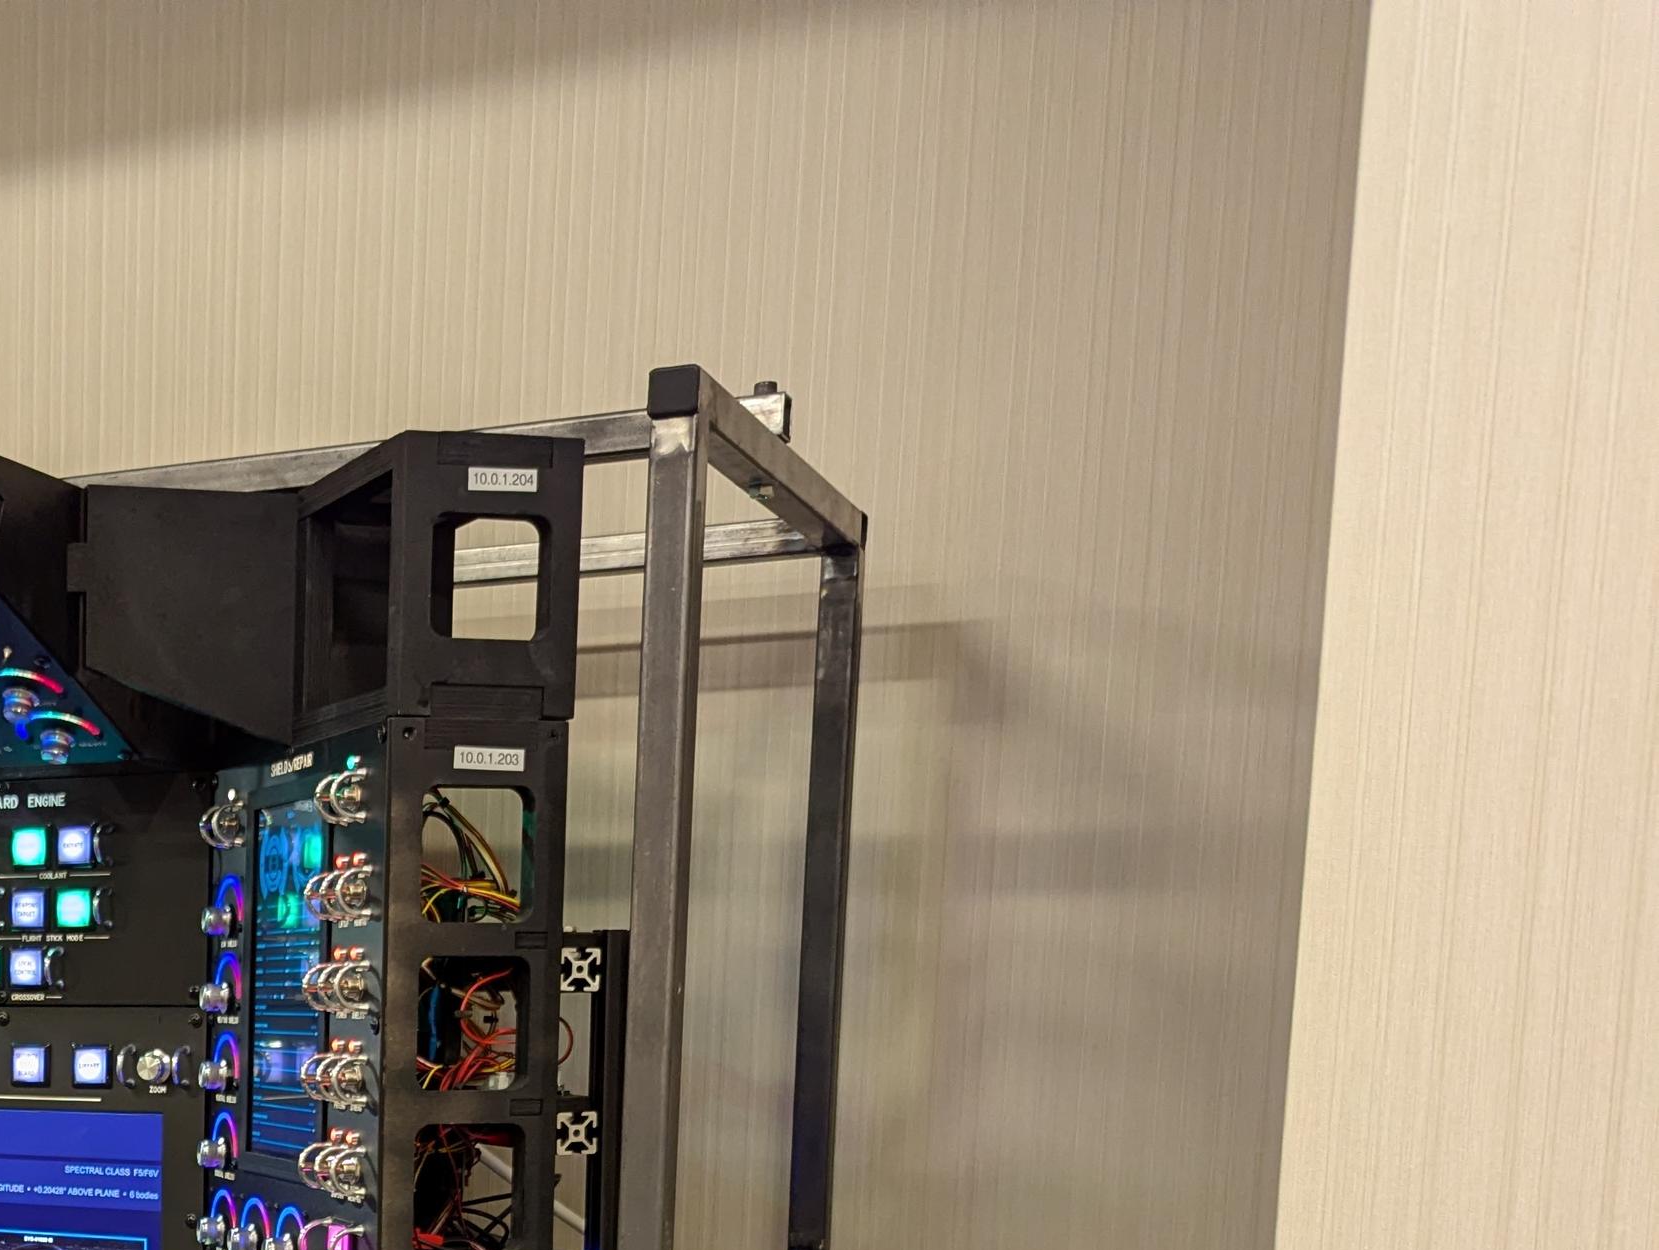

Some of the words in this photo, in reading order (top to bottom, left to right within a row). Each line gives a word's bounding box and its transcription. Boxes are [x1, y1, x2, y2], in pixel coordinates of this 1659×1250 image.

[473, 472, 534, 486] 10.0.1.204
[460, 752, 519, 766] 10.0.1.203
[27, 793, 65, 808] ENGINE
[39, 872, 67, 880] COOLANT
[63, 934, 83, 942] MODE
[149, 1086, 166, 1094] ZOOM
[65, 1165, 104, 1175] SPECTRAL
[105, 1167, 131, 1176] CLASS
[68, 1187, 93, 1196] ABOVE
[94, 1188, 120, 1198] PLANE
[135, 1190, 159, 1200] bodies
